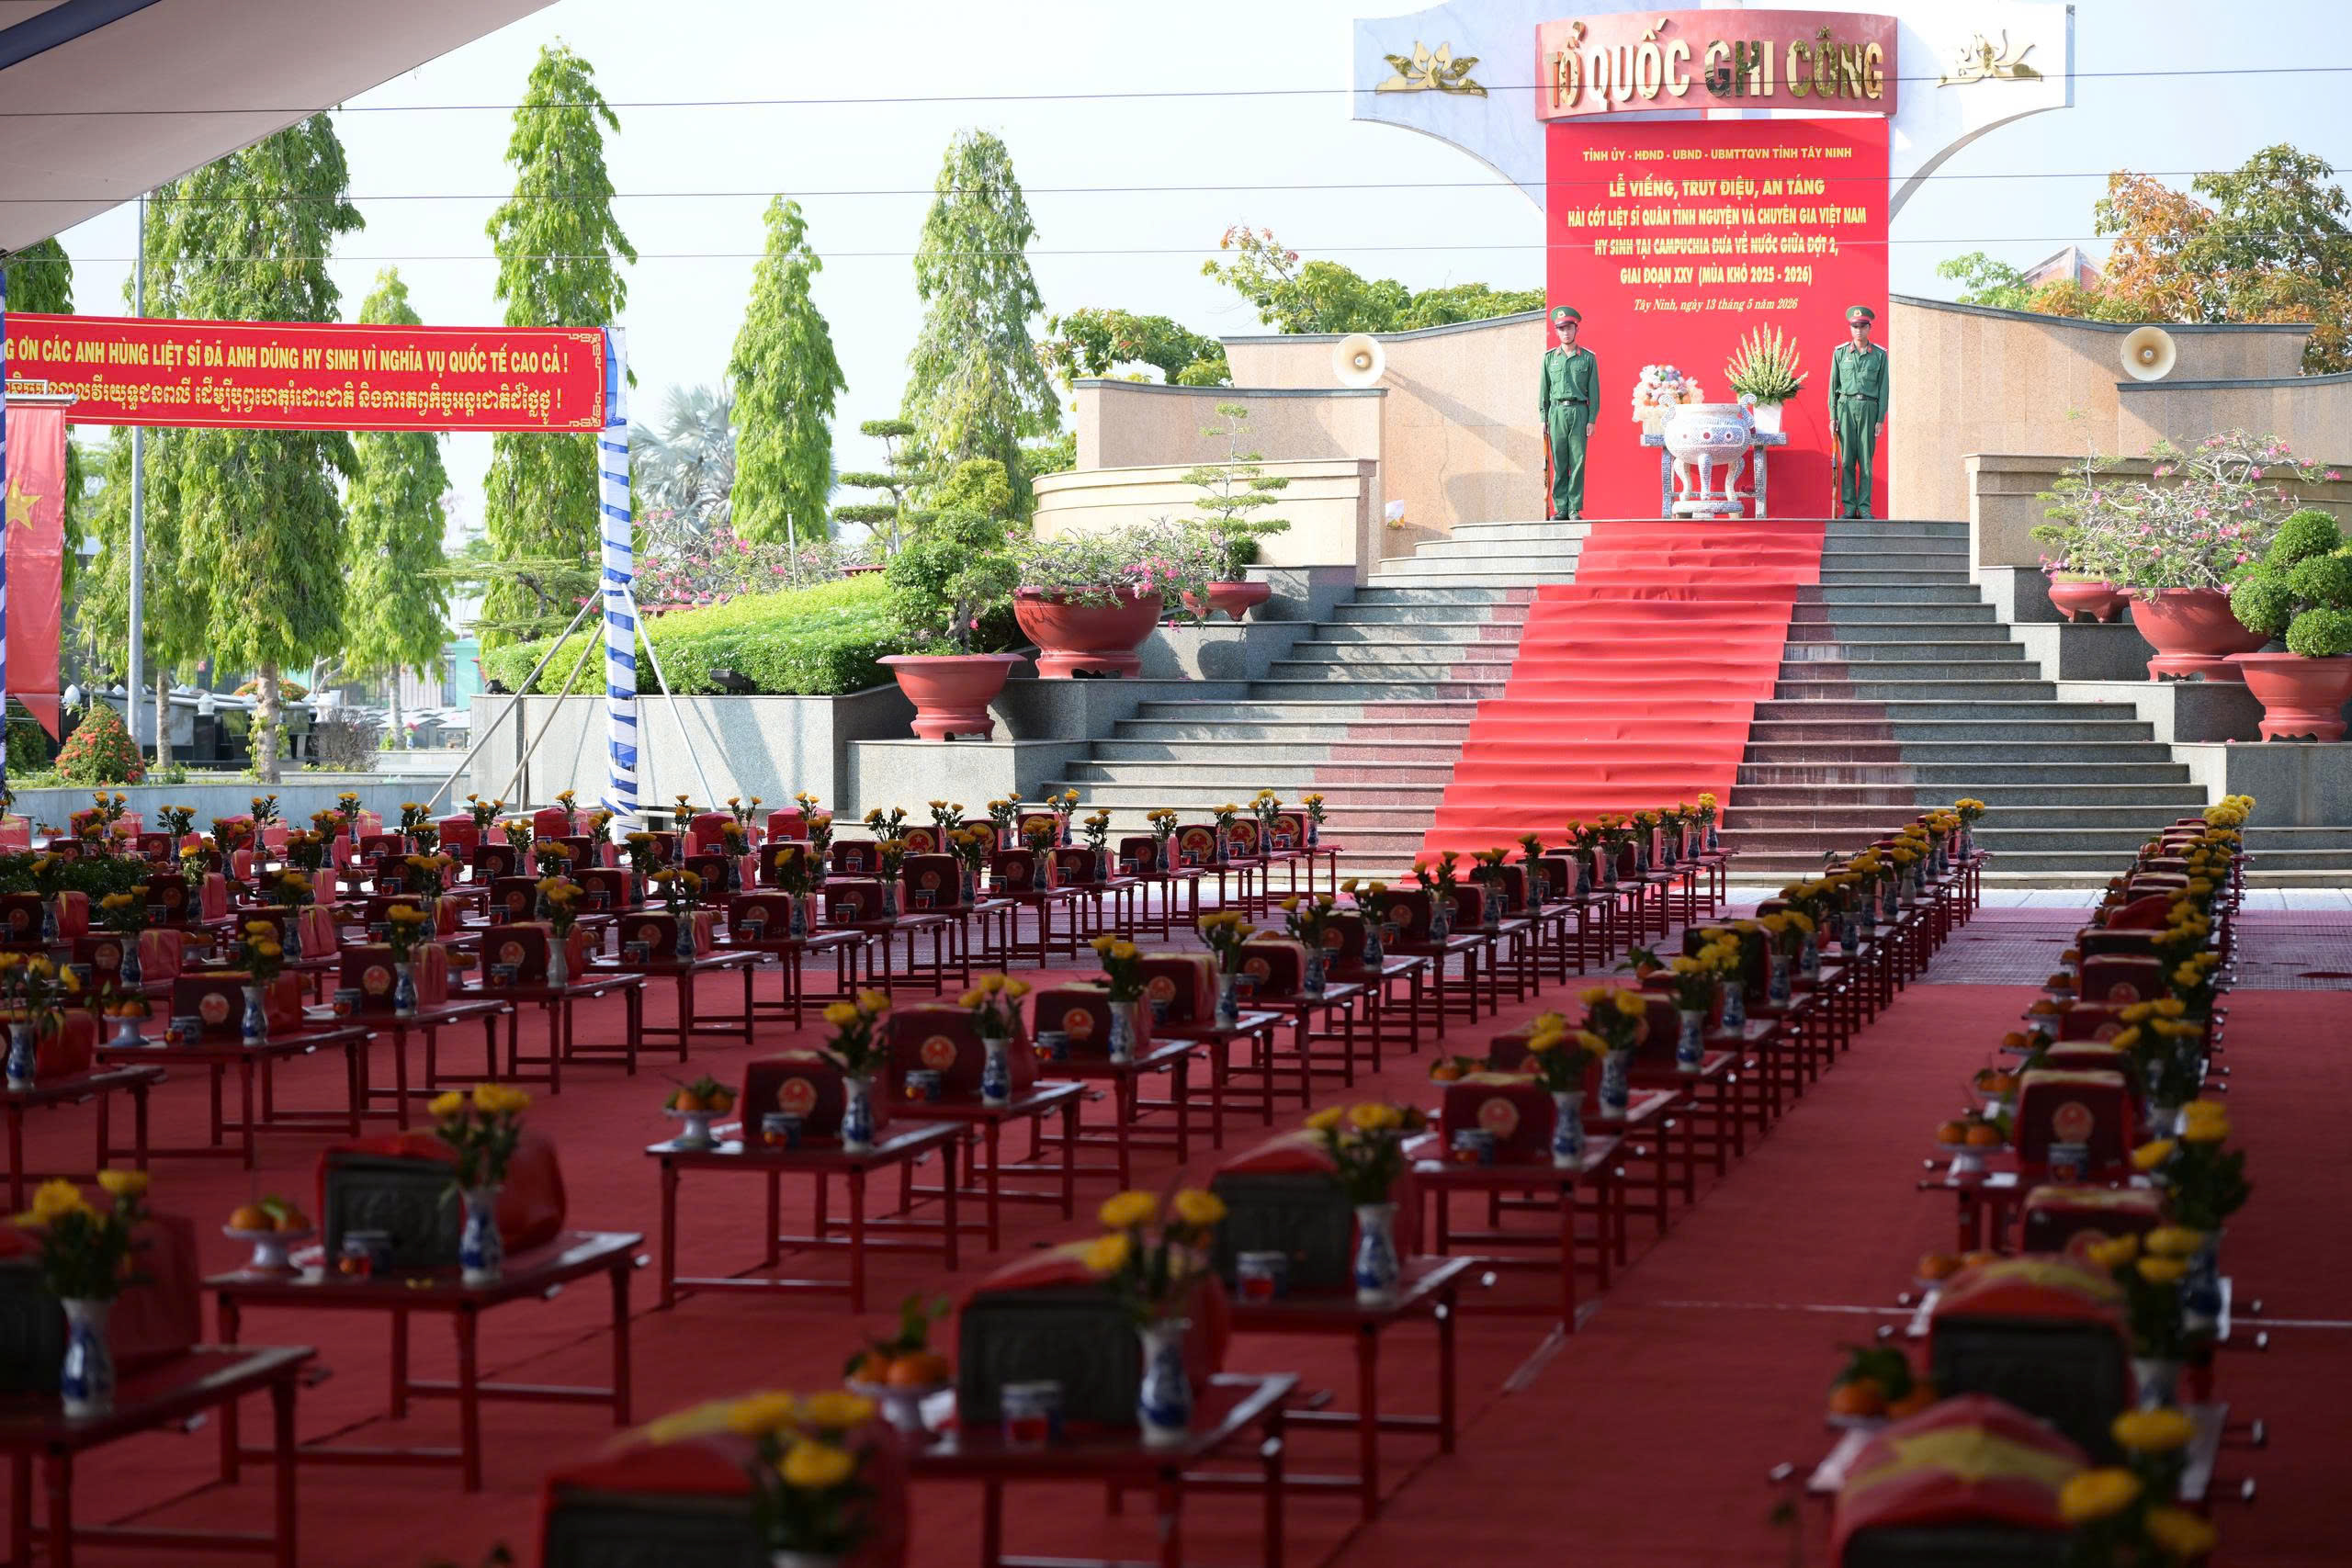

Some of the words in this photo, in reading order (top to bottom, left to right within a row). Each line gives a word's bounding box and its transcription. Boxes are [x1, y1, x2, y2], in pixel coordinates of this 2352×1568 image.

[1585, 17, 1691, 111] QUỐC
[1704, 39, 1774, 97] GHI
[1786, 26, 1884, 99] CÔNG
[1583, 148, 1608, 162] TỈNH
[1611, 147, 1625, 161] ỦY
[1634, 150, 1664, 160] HĐND
[1673, 150, 1702, 159] UBND
[1711, 149, 1770, 159] UBMTTQVN
[1772, 145, 1798, 158] TỈNH
[1801, 146, 1822, 158] TÂY
[1826, 148, 1851, 157] NINH
[1610, 173, 1625, 197] LỄ
[1630, 173, 1679, 200] VIẾNG,
[1682, 180, 1716, 197] TRUY
[1720, 175, 1758, 200] ĐIỆU,
[1762, 179, 1783, 196] AN
[1787, 173, 1826, 196] TÁNG
[1568, 206, 1585, 227] HÀI
[1588, 204, 1605, 226] CỐT
[1608, 206, 1628, 231] LIỆT
[1631, 206, 1640, 226] SĨ
[1643, 206, 1670, 226] QUÂN
[1673, 203, 1695, 225] TÌNH
[1699, 205, 1739, 229] NGUYỆN
[1742, 204, 1755, 224] VÀ
[1758, 204, 1796, 224] CHUYÊN
[1800, 208, 1817, 224] GIA
[1819, 204, 1841, 228] VIỆT
[1844, 208, 1866, 223] NAM
[1595, 240, 1608, 254] HY
[1611, 240, 1634, 254] SINH
[1636, 239, 1652, 259] TẠI
[1655, 238, 1710, 254] CAMPUCHIA
[1713, 235, 1732, 254] ĐƯA
[1736, 231, 1747, 254] VỀ
[1751, 233, 1778, 254] NƯỚC
[1808, 234, 1826, 257] ĐỢT
[1830, 238, 1838, 255] 2,
[1621, 268, 1641, 284] GIAI
[1644, 267, 1671, 288] ĐOẠN
[1674, 267, 1693, 283] XXV
[1699, 262, 1724, 287] (MÙA
[1727, 263, 1747, 283] KHÔ
[1751, 266, 1774, 282] 2025
[1784, 265, 1812, 286] 2026)
[1634, 299, 1651, 312] Tây
[1654, 299, 1678, 311] Ninh,
[1680, 299, 1703, 312] ngày
[1705, 299, 1716, 310] 13
[1718, 299, 1746, 312] tháng
[1747, 299, 1753, 309] 5
[1755, 299, 1774, 309] năm
[1777, 299, 1798, 309] 2026
[18, 335, 39, 360] ƠN
[42, 334, 71, 362] CÁC
[75, 342, 105, 363] ANH
[109, 337, 148, 365] HÙNG
[153, 340, 183, 372] LIỆT
[187, 339, 201, 367] SĨ
[204, 340, 223, 367] ĐÃ
[227, 346, 256, 367] ANH
[261, 342, 299, 368] DŨNG
[303, 349, 322, 369] HY
[326, 349, 358, 370] SINH
[363, 344, 376, 370] VÌ
[380, 344, 423, 371] NGHĨA
[426, 351, 445, 378] VỤ
[449, 343, 486, 373] QUỐC
[490, 344, 507, 372] TẾ
[511, 352, 538, 373] CAO
[542, 344, 560, 373] CẢ
[563, 352, 569, 374] !
